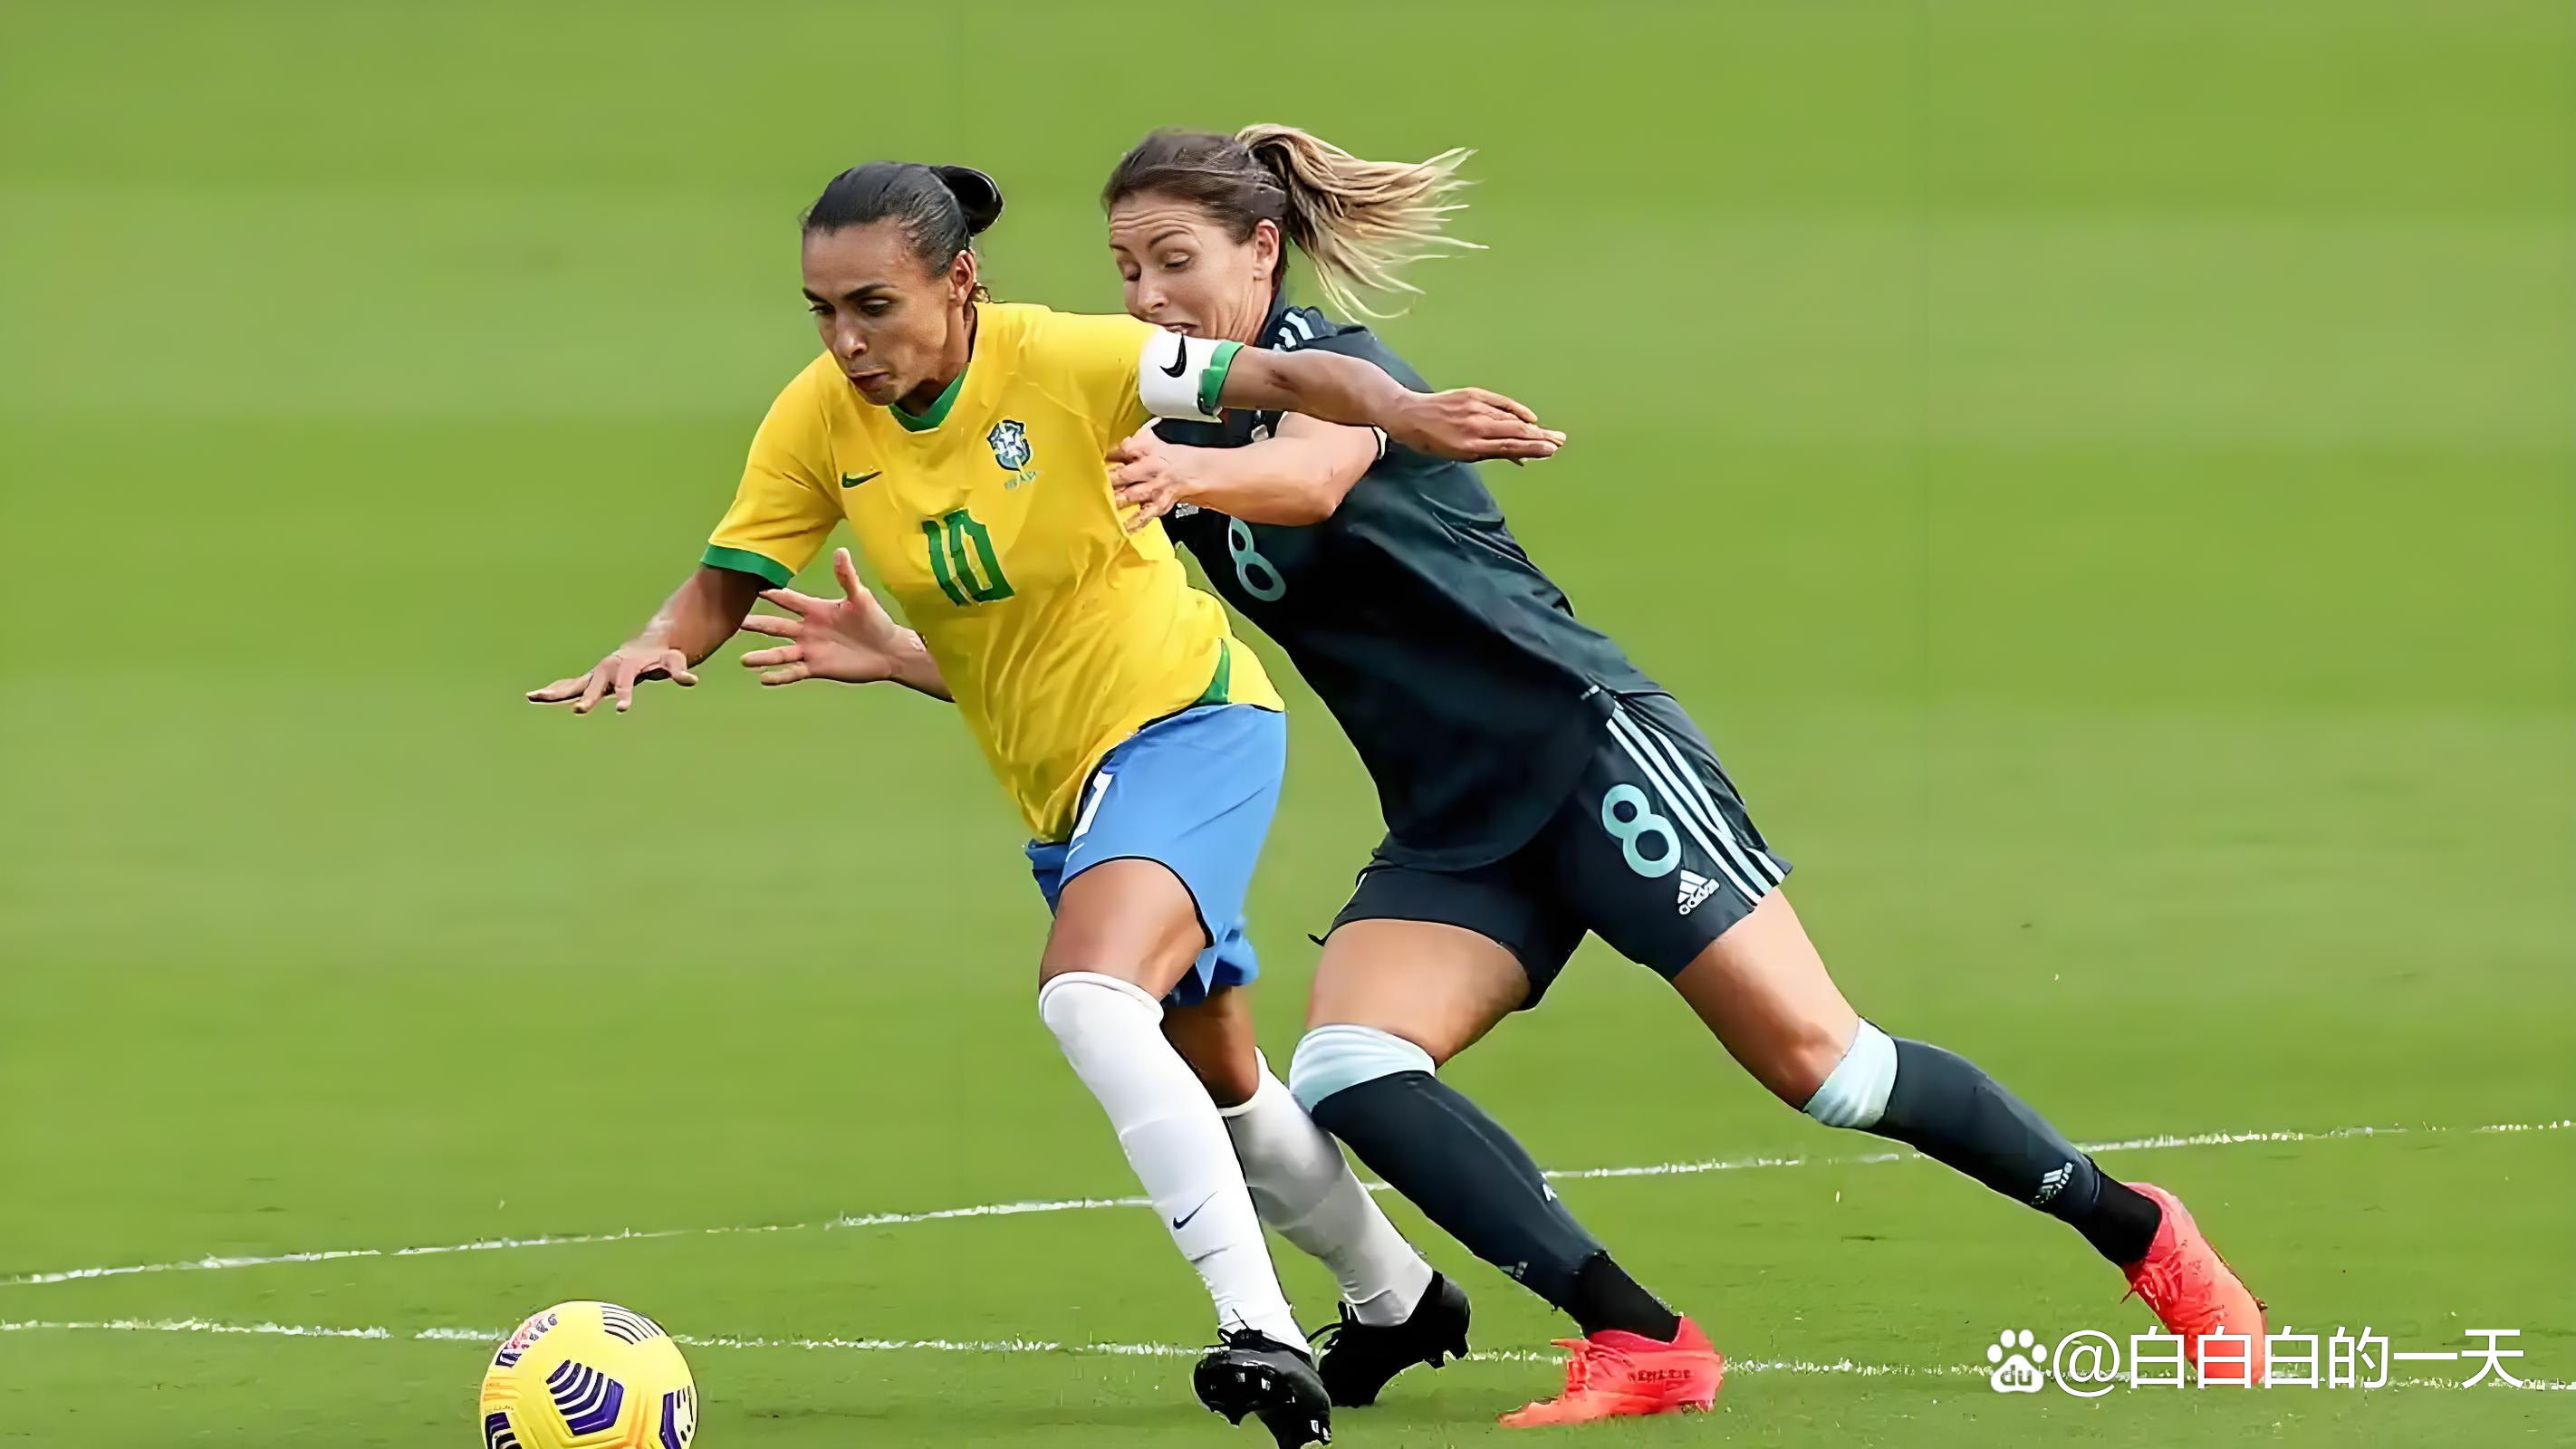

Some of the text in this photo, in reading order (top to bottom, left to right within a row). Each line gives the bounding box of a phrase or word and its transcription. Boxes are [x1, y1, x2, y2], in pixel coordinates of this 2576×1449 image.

[922, 508, 1014, 607] 10
[1228, 515, 1286, 602] 8
[1602, 783, 1681, 878] 8
